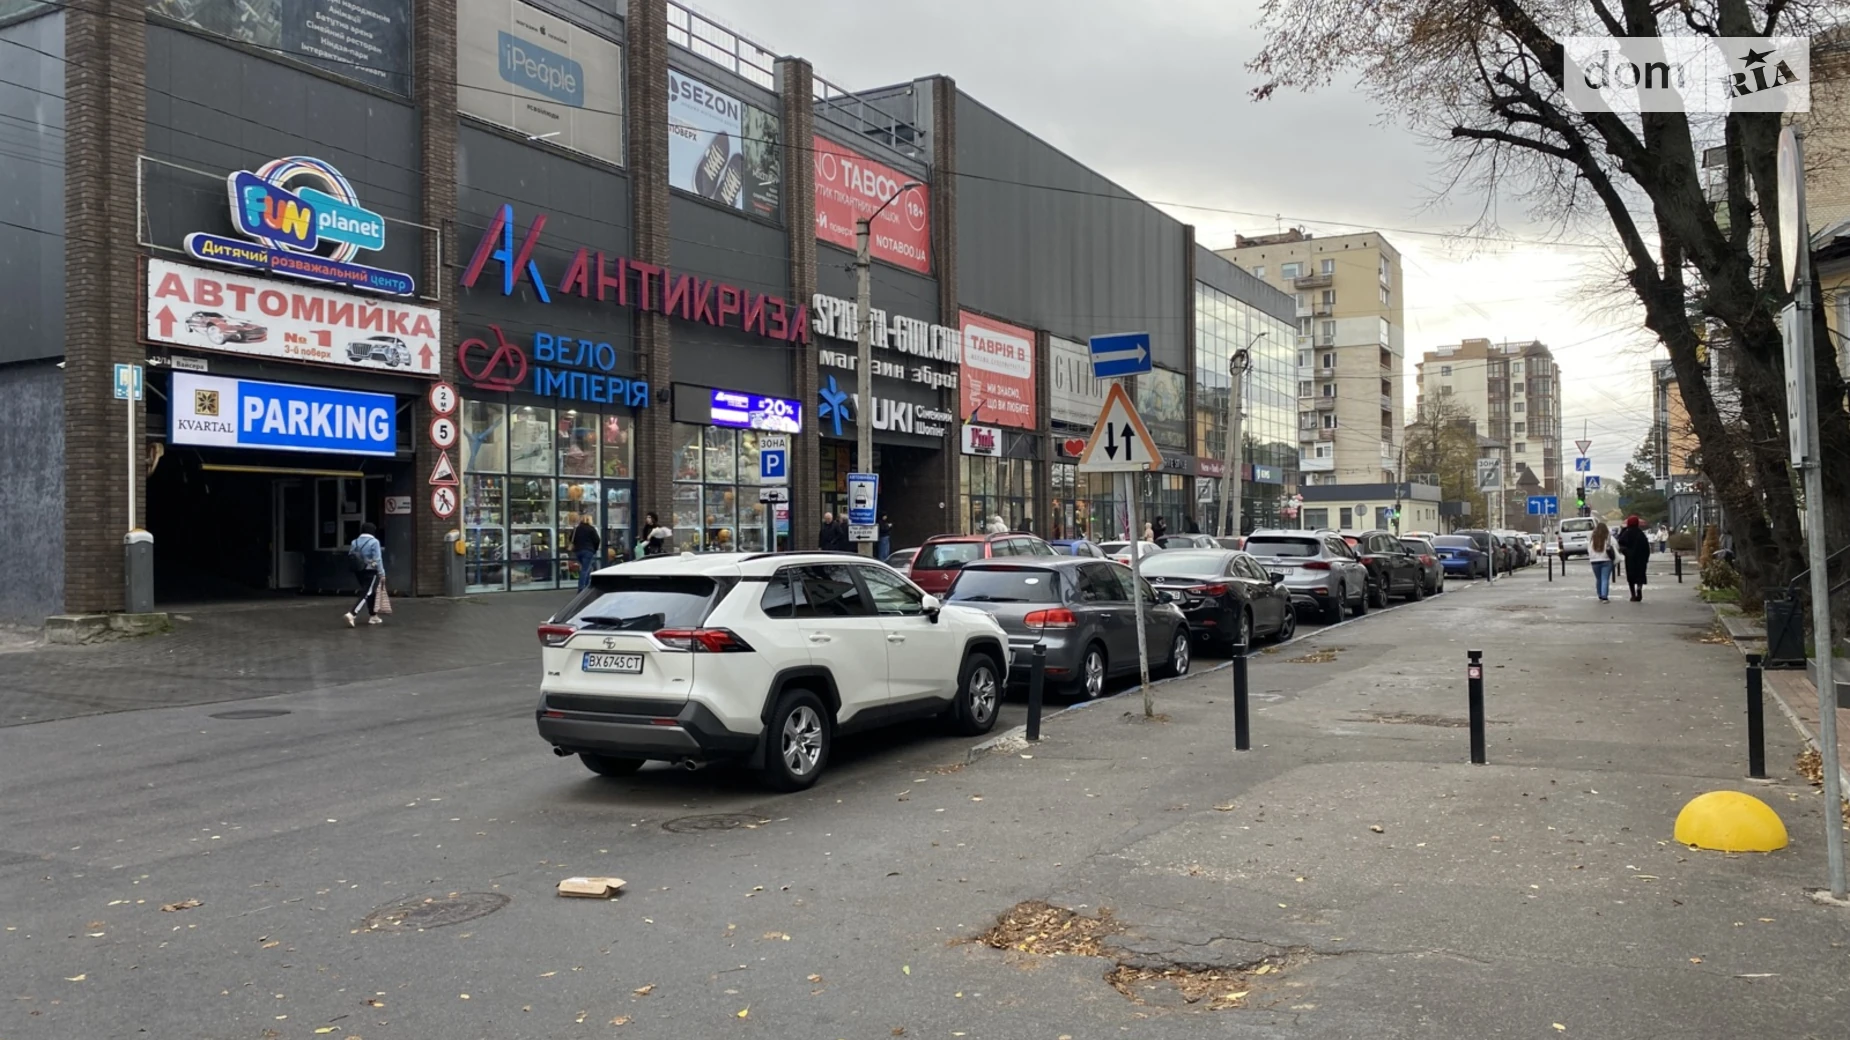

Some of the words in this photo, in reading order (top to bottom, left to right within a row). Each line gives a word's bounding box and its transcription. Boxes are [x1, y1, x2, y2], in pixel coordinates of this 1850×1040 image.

[316, 12, 349, 30] Батутна
[350, 26, 373, 39] арена
[328, 6, 361, 23] Анімації
[306, 20, 345, 40] Сімейний
[346, 36, 382, 54] ресторан
[301, 42, 354, 66] Інтерактивні
[507, 44, 576, 93] iPeople
[681, 80, 738, 120] SEZON
[668, 124, 697, 142] ПОВЕРХ
[840, 160, 899, 206] TABOO
[243, 185, 311, 240] FUN
[319, 209, 380, 238] planet
[906, 202, 924, 218] 18+
[829, 222, 853, 236] поверх
[876, 234, 926, 261] NOTABOO.UA
[202, 240, 268, 264] Дитячий
[271, 255, 368, 282] розважальний
[370, 275, 406, 292] центр
[154, 272, 436, 339] АВТОМИЙКА
[559, 247, 808, 344] АНТИКРИЗА
[284, 344, 299, 355] 3-й
[300, 346, 332, 359] поверх
[534, 331, 616, 371] ВЕЛО
[970, 335, 1014, 359] ТАВРІЯ
[1017, 348, 1025, 362] В
[819, 350, 904, 379] магзин
[911, 366, 958, 390] зброї
[534, 366, 650, 408] ІМПЕРІЯ
[987, 383, 997, 394] МИ
[997, 384, 1021, 399] ЗНАЄМО,
[243, 395, 389, 442] PARKING
[915, 404, 953, 422] Сімейний
[987, 398, 997, 410] ЩО
[998, 401, 1006, 411] ВИ
[1007, 402, 1030, 415] ЛЮБИТЕ
[178, 420, 234, 433] KVARTAL
[440, 425, 448, 439] 5
[915, 422, 945, 437] Шопінг
[971, 427, 994, 446] Pink
[761, 439, 785, 449] ЗОНА
[767, 454, 780, 474] P
[589, 656, 601, 668] BX
[603, 656, 625, 668] 6745
[626, 657, 640, 669] CT
